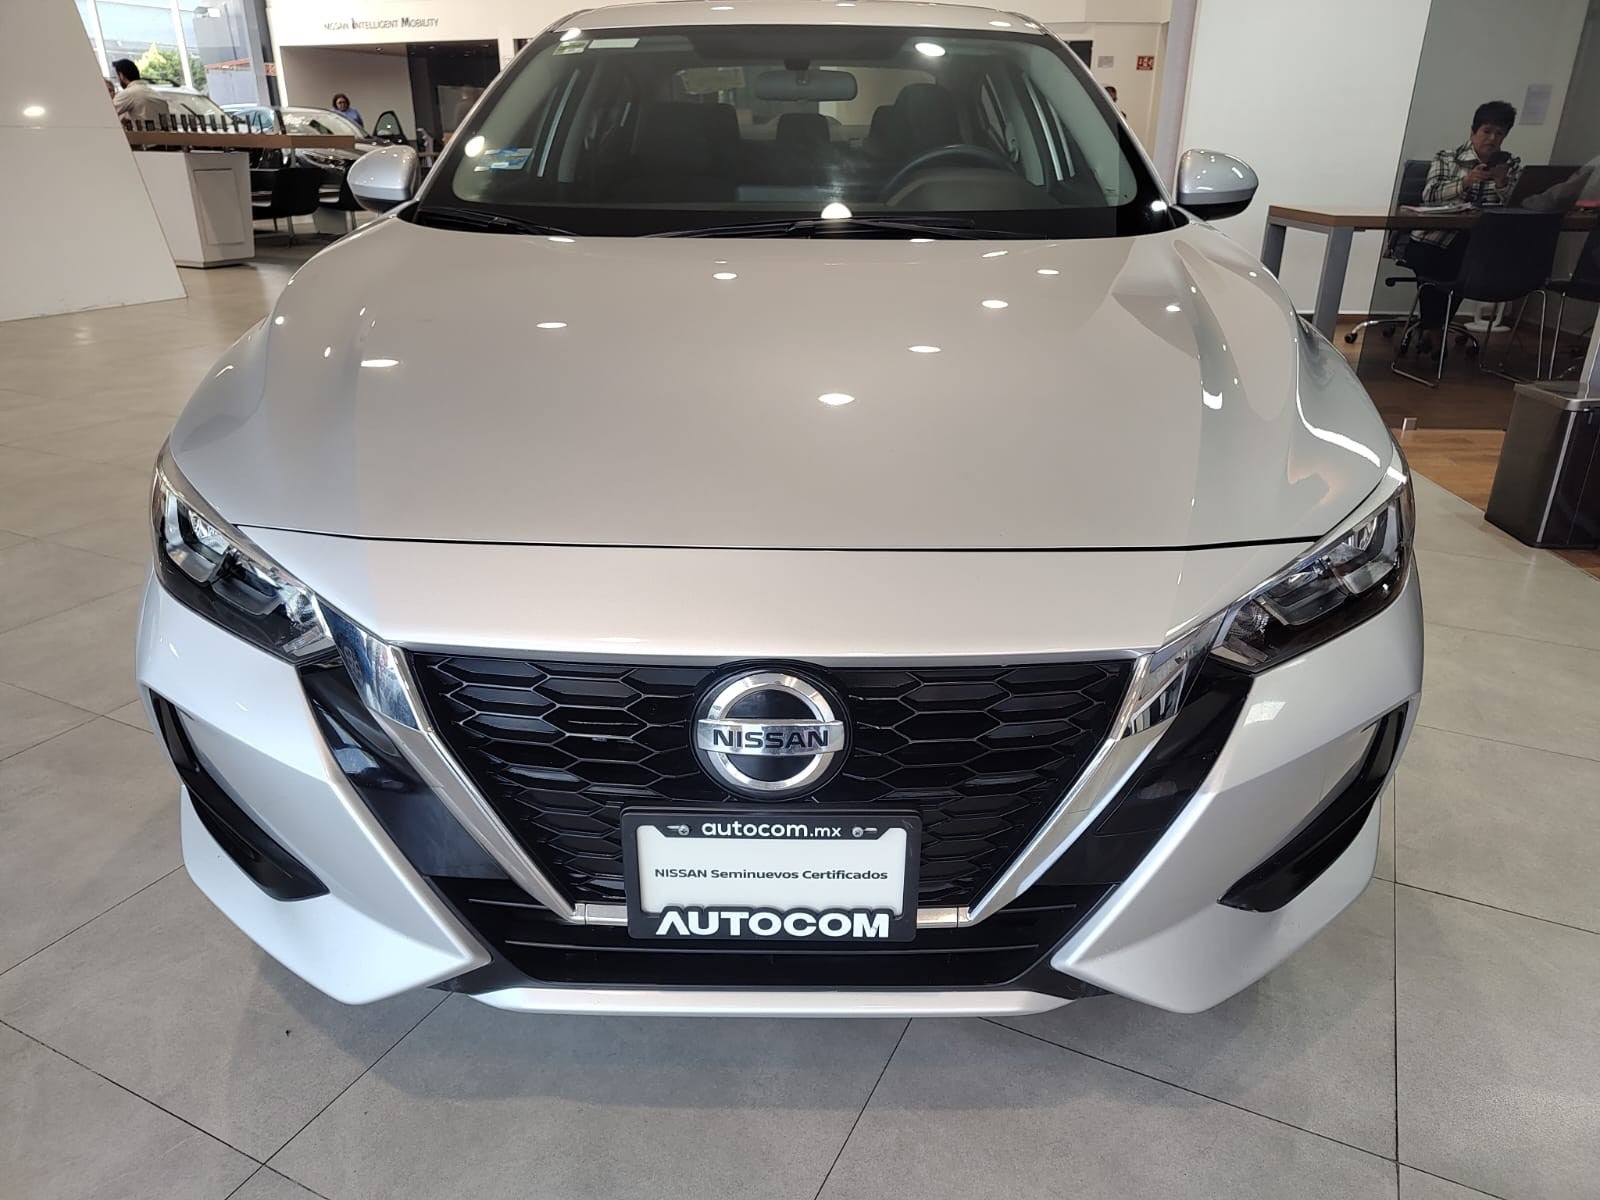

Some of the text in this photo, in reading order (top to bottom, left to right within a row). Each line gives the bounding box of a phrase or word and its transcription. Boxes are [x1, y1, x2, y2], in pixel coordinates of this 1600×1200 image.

[352, 17, 399, 30] INTELLIGENT
[401, 17, 440, 29] MOBILITY
[713, 729, 829, 749] NISSAN
[701, 820, 842, 838] autocom.mx
[654, 868, 889, 881] NISSAN Seminuevos Certificados
[655, 910, 890, 938] AUTOCOM
